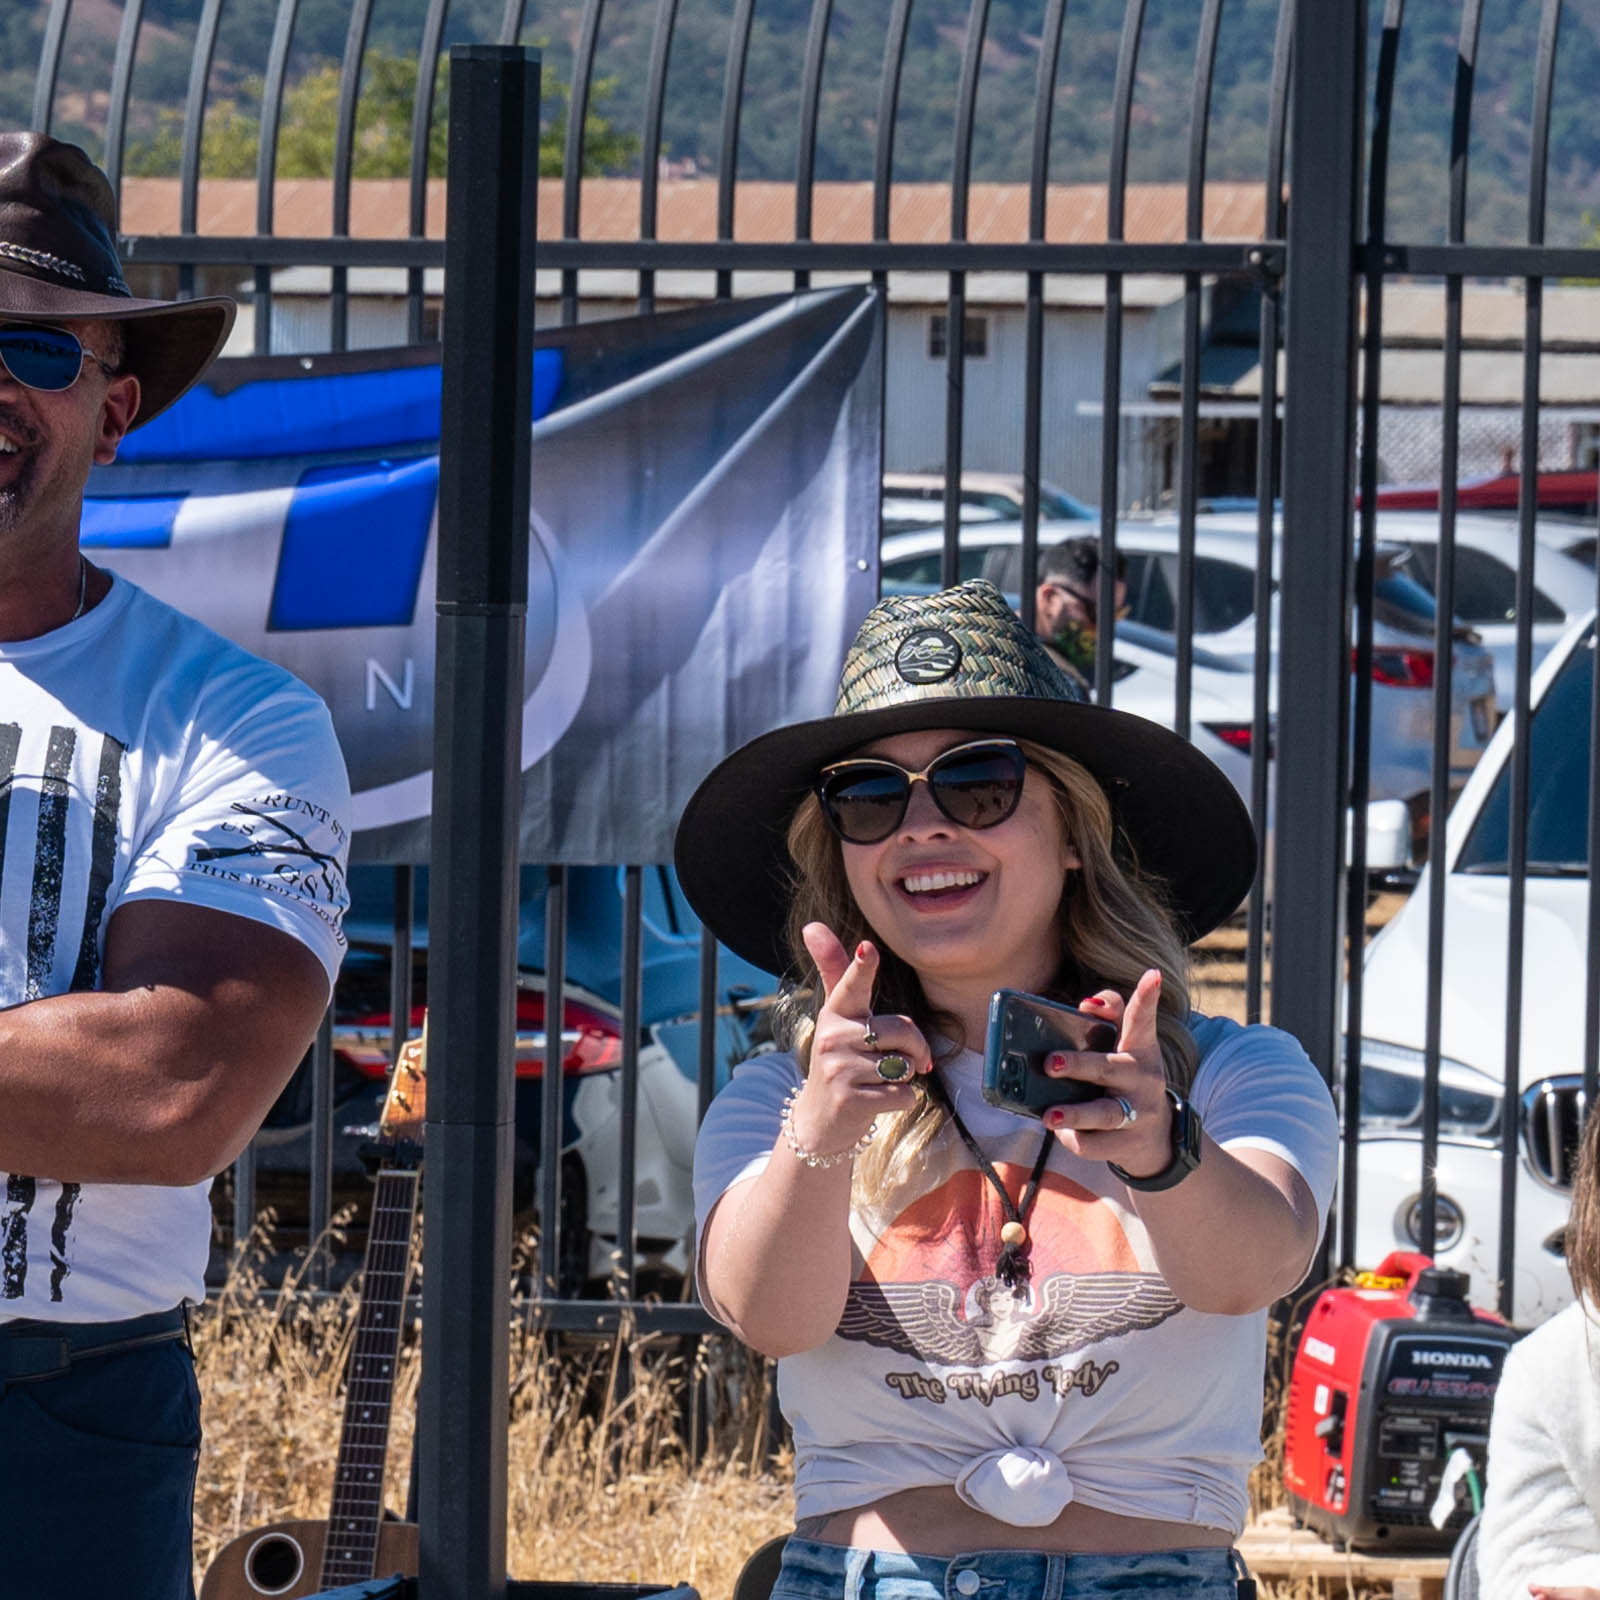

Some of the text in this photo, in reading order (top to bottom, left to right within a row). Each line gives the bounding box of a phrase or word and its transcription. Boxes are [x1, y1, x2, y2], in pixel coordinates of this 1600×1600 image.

[253, 794, 330, 824] RUNT
[186, 861, 242, 882] THIS
[1411, 1350, 1494, 1369] HONDA
[886, 1360, 1120, 1407] The Flying Lady
